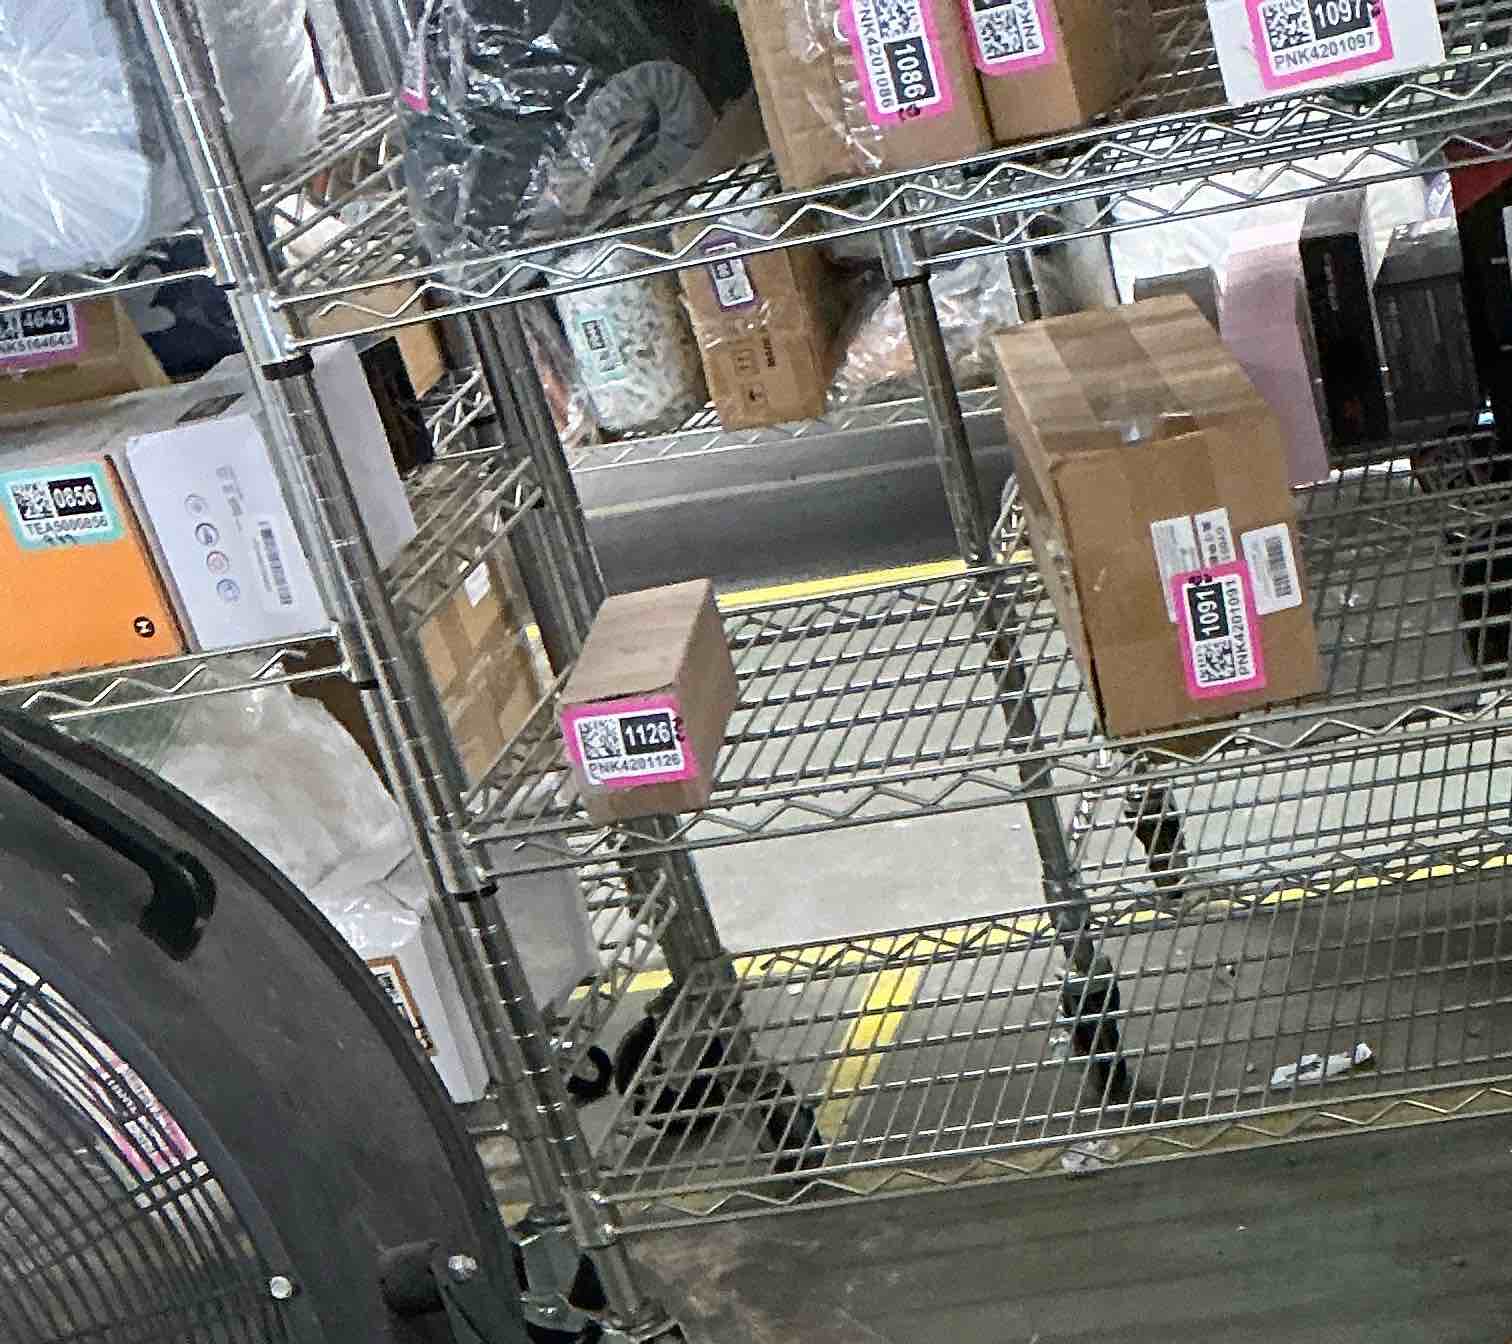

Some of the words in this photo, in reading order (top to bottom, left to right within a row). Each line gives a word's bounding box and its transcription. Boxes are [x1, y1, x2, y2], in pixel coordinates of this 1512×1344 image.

[1314, 0, 1363, 29] 1097
[1273, 31, 1375, 70] PNK4201097
[894, 44, 928, 100] 1086
[1194, 589, 1221, 637] 1091
[625, 721, 672, 747] 1126
